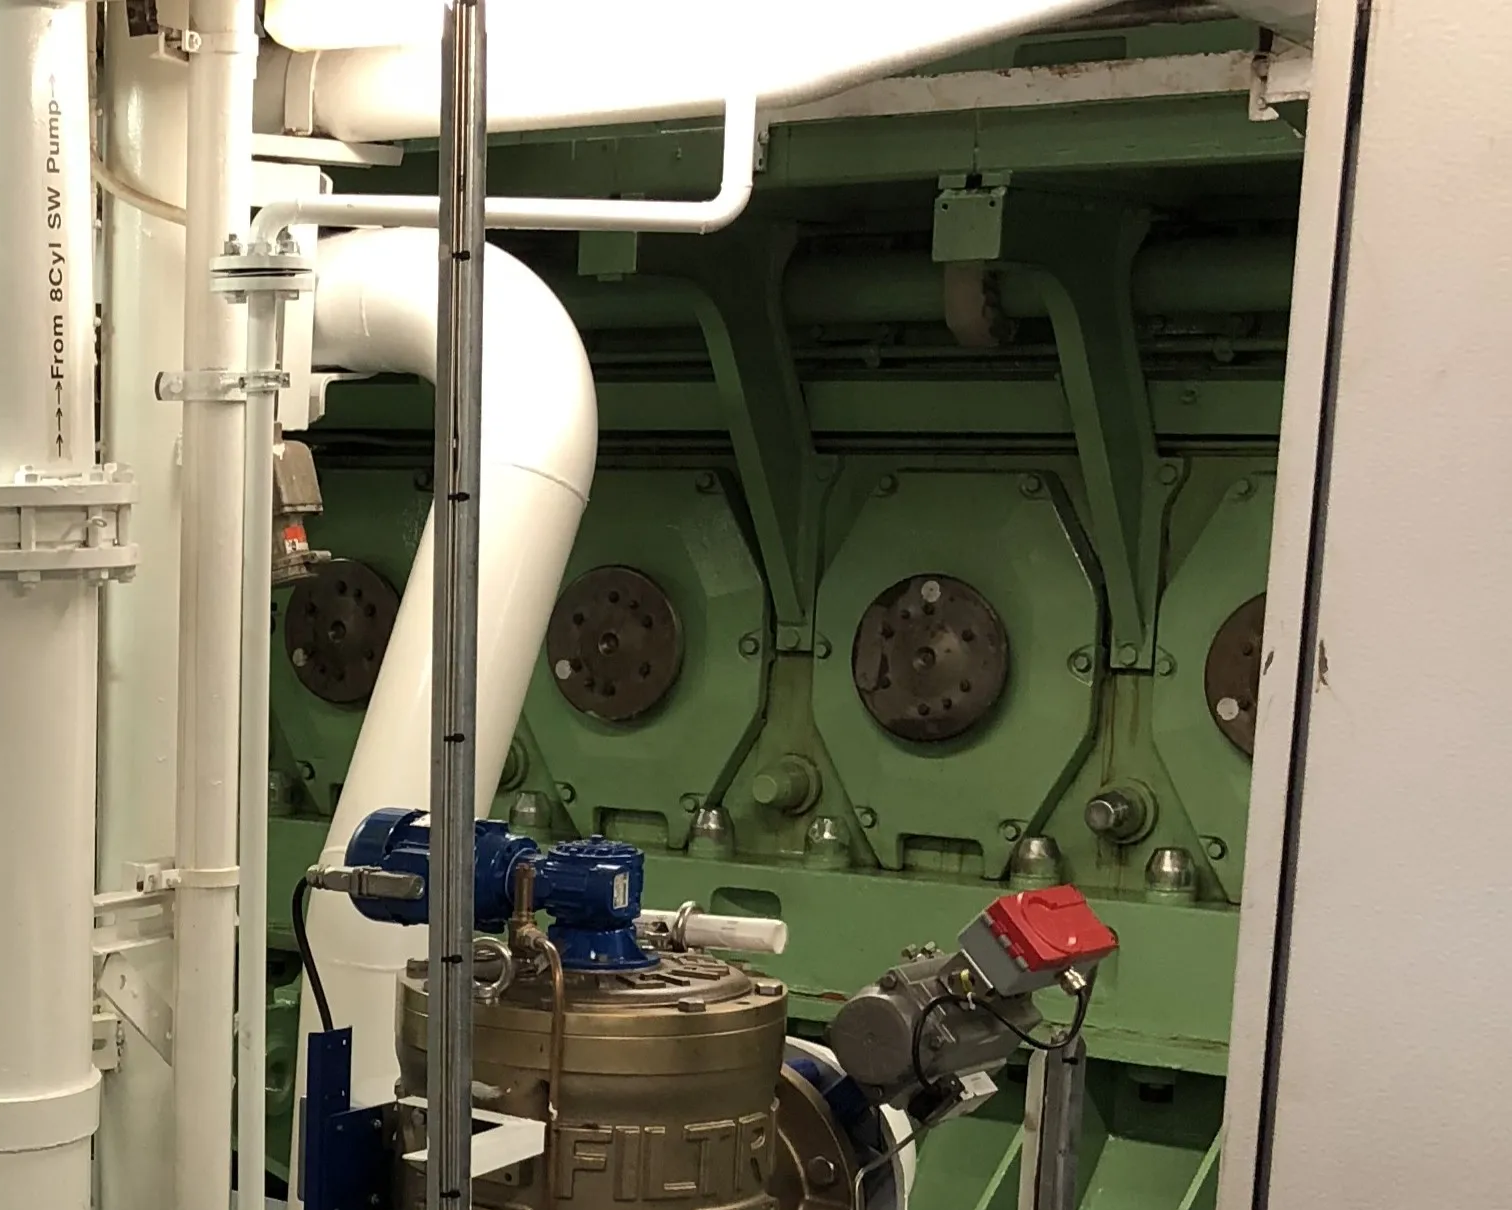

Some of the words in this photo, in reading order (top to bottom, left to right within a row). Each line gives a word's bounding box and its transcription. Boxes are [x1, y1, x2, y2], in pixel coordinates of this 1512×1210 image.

[46, 101, 63, 173] Pump
[47, 187, 62, 229] SW
[49, 241, 66, 303] 8Cyl
[50, 313, 65, 379] From
